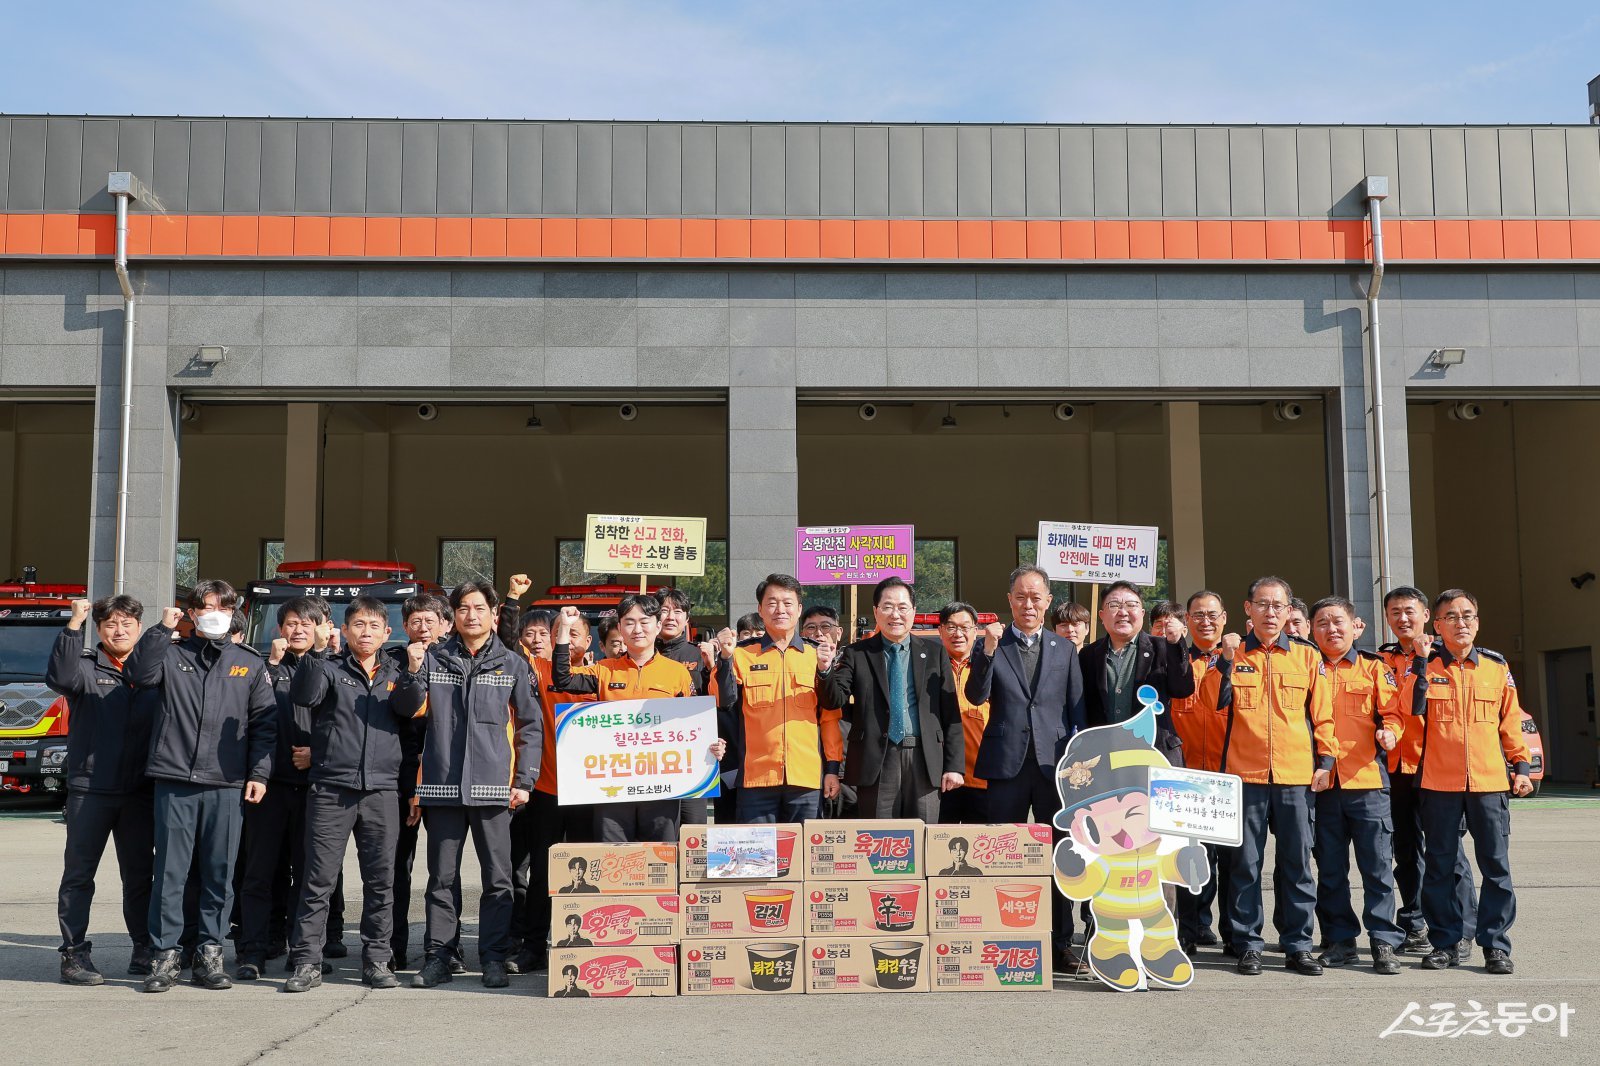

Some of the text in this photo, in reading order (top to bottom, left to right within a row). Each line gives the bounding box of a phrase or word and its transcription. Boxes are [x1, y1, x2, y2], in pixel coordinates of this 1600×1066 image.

[594, 525, 688, 544] 침착한 신고 전화,
[1047, 532, 1137, 551] 화재에는 대피 먼저
[802, 535, 895, 551] 소방안전 사각지대
[607, 544, 698, 561] 신속한 소방 출동
[1059, 550, 1148, 569] 안전에는 대비 먼저
[815, 553, 907, 570] 개선하니 안전지대
[305, 587, 361, 596] 전남소방
[228, 665, 249, 677] 119
[571, 713, 624, 729] 여행완도
[613, 731, 665, 747] 힐링온도
[583, 749, 693, 780] 안전해요!
[627, 784, 672, 796] 완도소방서
[1184, 793, 1206, 803] 사람을
[1209, 795, 1231, 806] 살리고
[1155, 800, 1182, 813] 청렴은
[1185, 807, 1207, 818] 사회를
[1187, 822, 1215, 832] 완도소방서
[825, 834, 846, 844] 농심
[854, 833, 911, 857] 육개장
[973, 838, 1018, 864] 왕뚜껑
[590, 859, 601, 881] 김치
[601, 854, 647, 883] 왕뚜껑
[873, 860, 908, 871] 사발면
[1120, 869, 1153, 888] 119
[700, 894, 721, 904] 농심
[825, 892, 848, 902] 농심
[949, 890, 970, 899] 농심
[754, 904, 784, 920] 김치
[878, 894, 901, 927] 辛
[1001, 900, 1038, 914] 새우탕
[589, 914, 631, 939] 왕뚜껑
[703, 950, 726, 961] 농심
[827, 948, 850, 959] 농심
[951, 945, 972, 955] 농심
[980, 944, 1039, 968] 육개장
[752, 960, 793, 976] 튀김우동
[876, 958, 917, 975] 튀김우동
[586, 965, 628, 990] 왕뚜껑
[1001, 971, 1036, 983] 사발면
